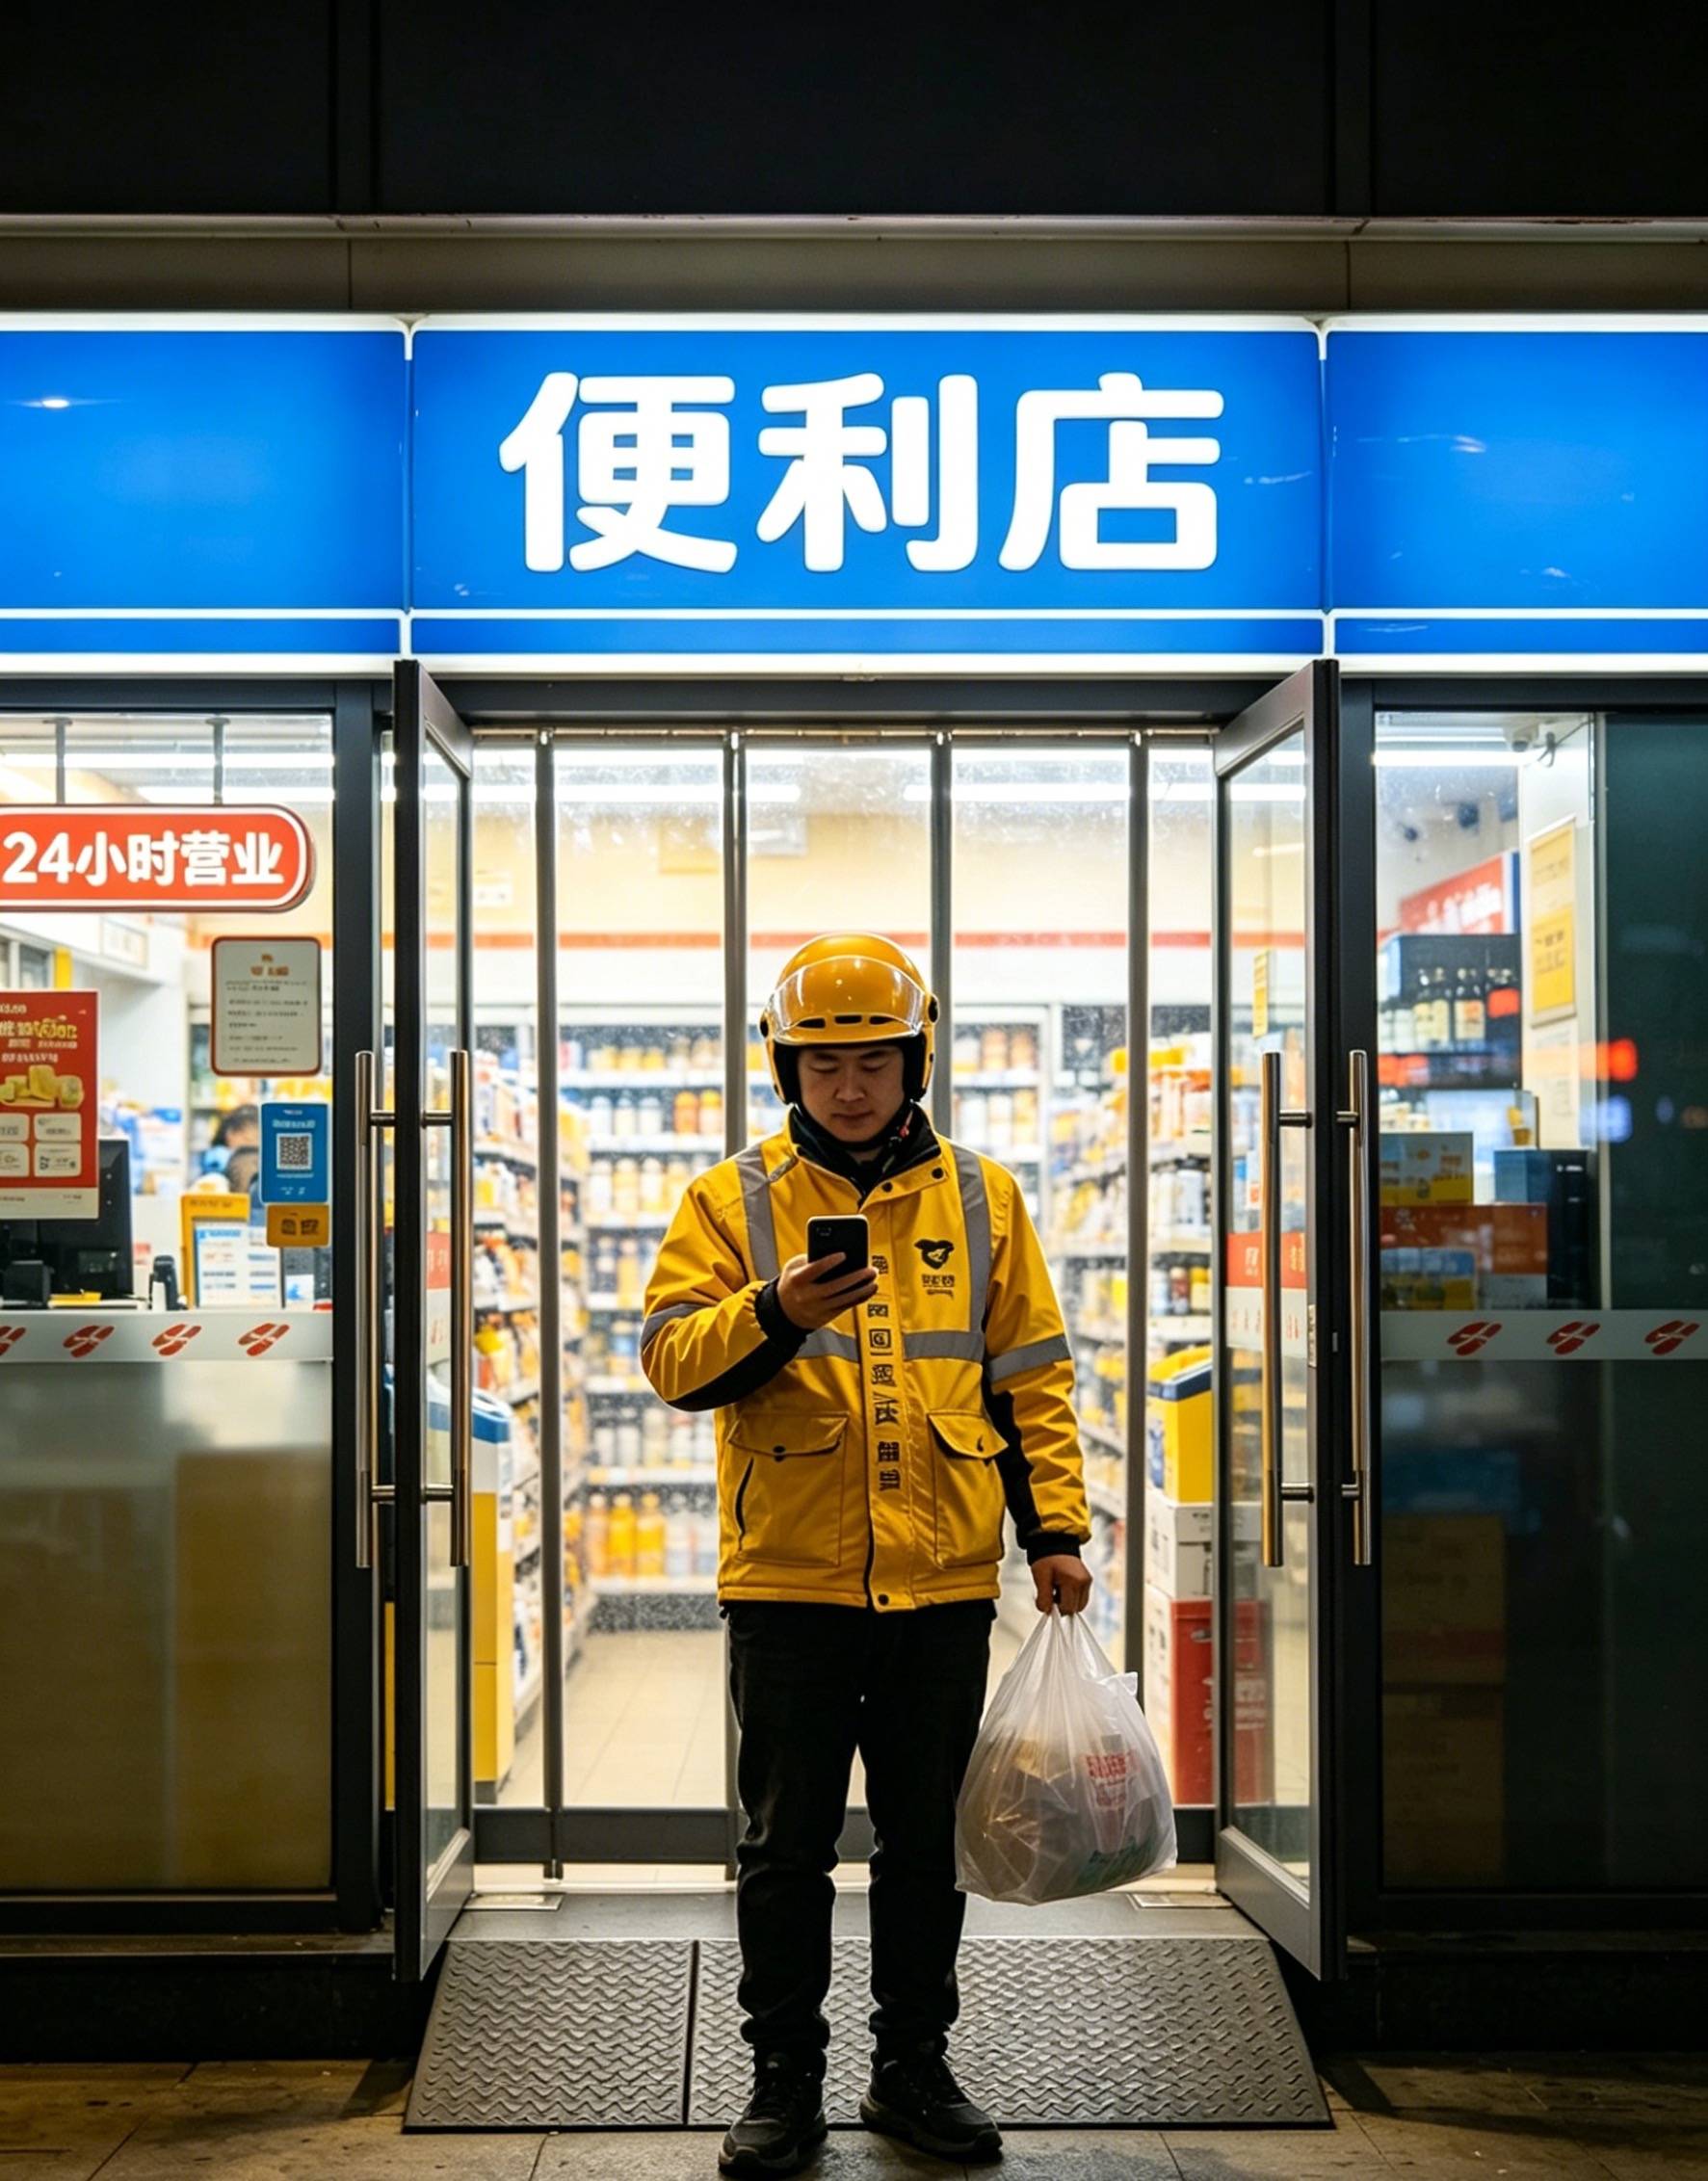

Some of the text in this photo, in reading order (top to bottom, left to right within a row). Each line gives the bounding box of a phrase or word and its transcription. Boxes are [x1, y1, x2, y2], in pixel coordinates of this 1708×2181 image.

[499, 372, 1223, 573] 便利店
[2, 829, 285, 887] 24小时营业
